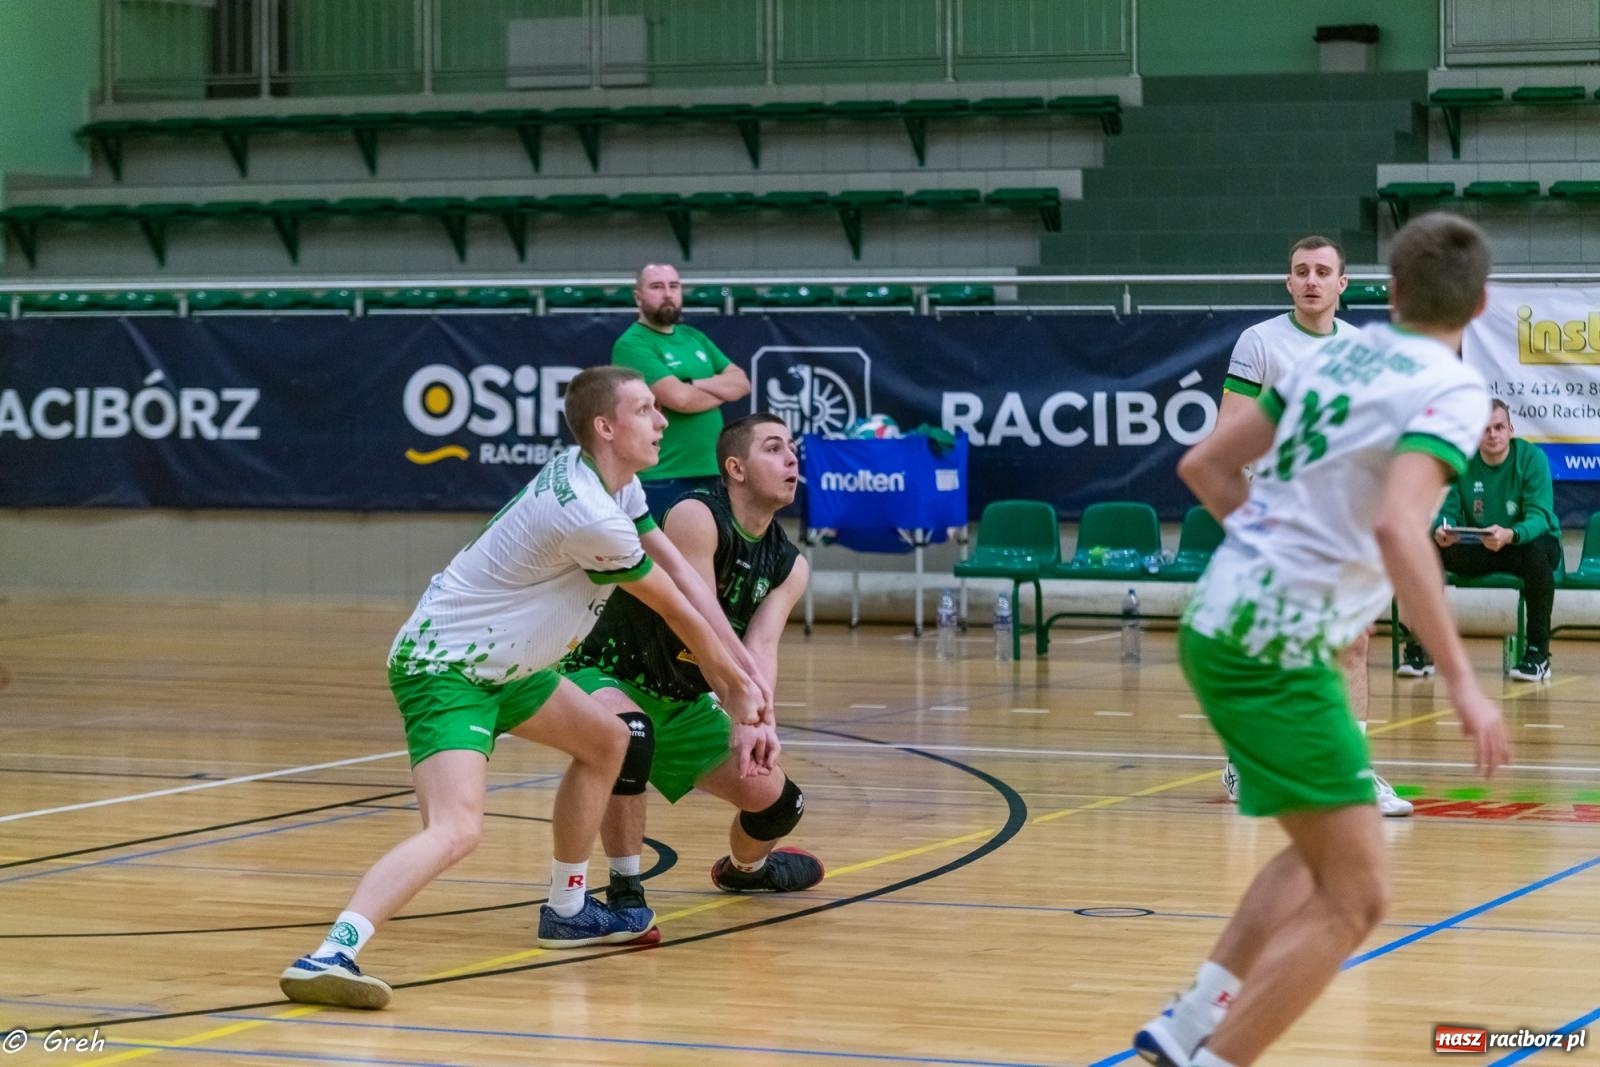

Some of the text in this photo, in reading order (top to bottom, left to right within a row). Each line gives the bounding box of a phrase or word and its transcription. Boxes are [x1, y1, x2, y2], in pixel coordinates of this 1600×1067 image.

[1507, 382, 1525, 396] 32
[1531, 381, 1560, 396] 414
[1565, 382, 1584, 396] 92
[1589, 382, 1600, 396] 8
[1565, 455, 1600, 469] ww
[820, 469, 906, 493] molten
[567, 874, 584, 888] R
